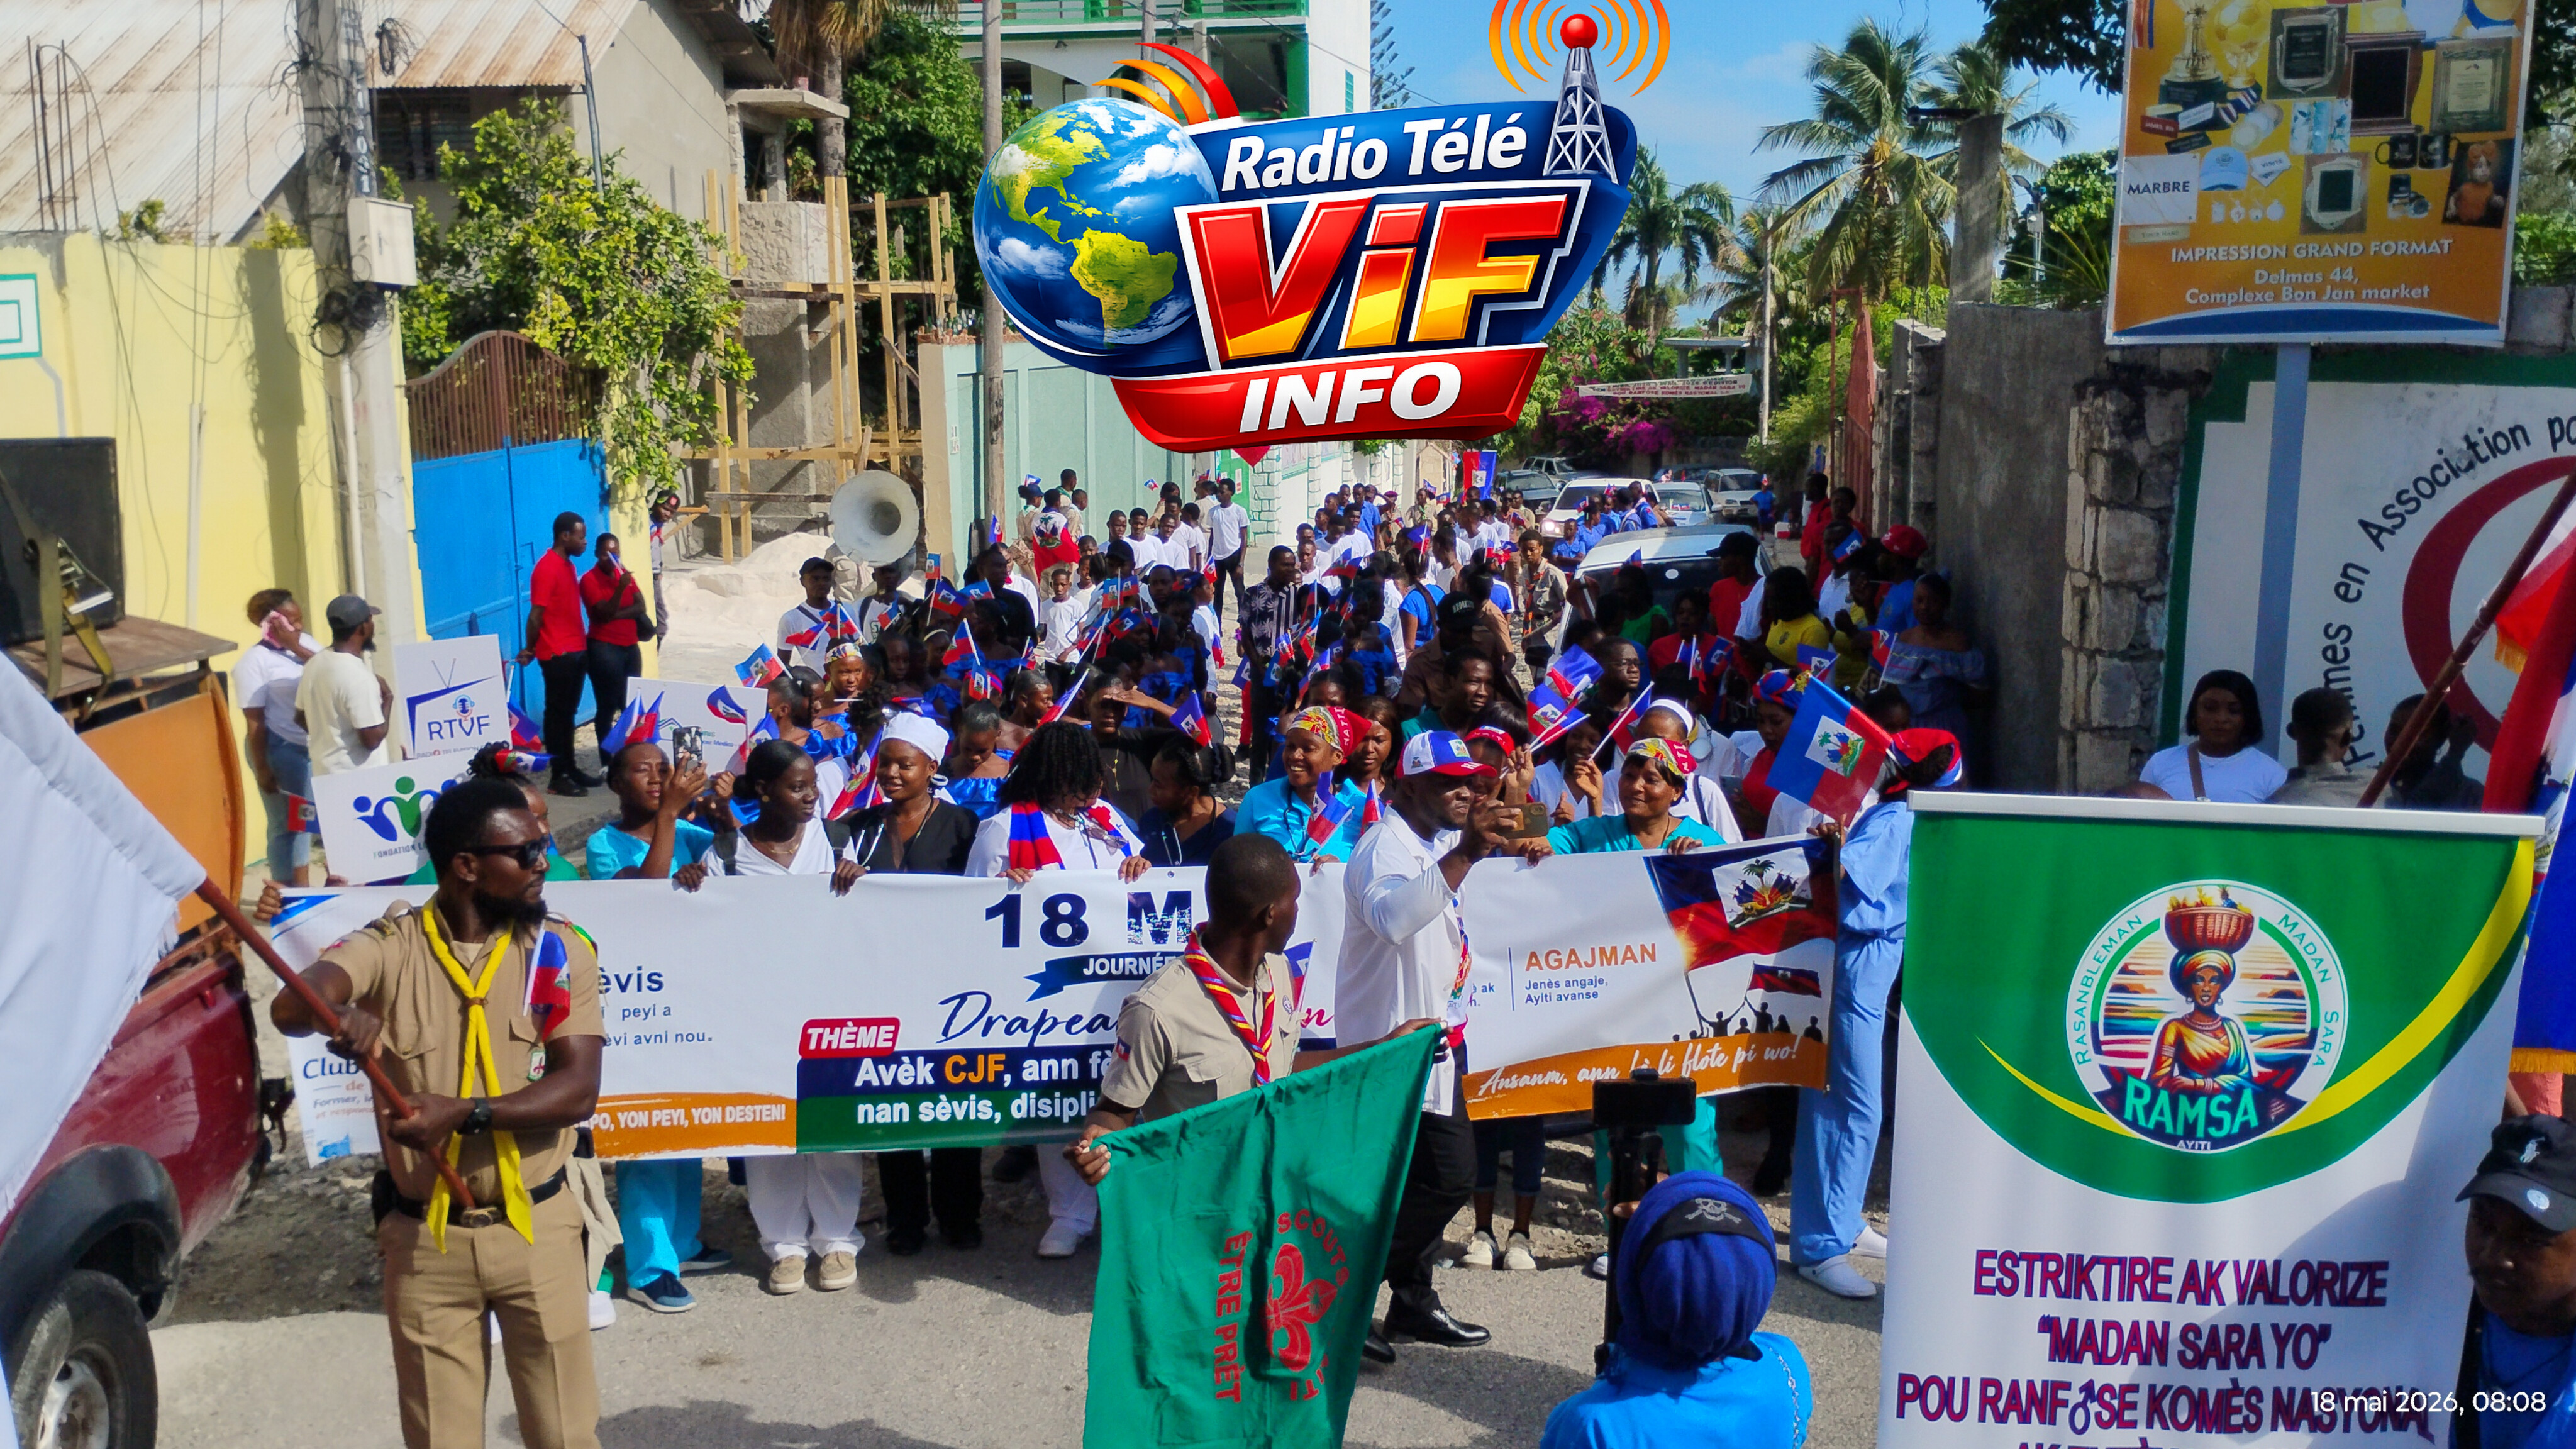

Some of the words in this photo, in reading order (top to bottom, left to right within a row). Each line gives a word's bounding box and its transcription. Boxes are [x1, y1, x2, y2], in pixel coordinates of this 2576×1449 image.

[2127, 180, 2190, 196] MARBRE
[2171, 243, 2287, 263] IMPRESSION
[2292, 242, 2365, 258] GRAND
[2370, 239, 2453, 256] FORMAT
[2255, 269, 2324, 286] Delmas
[2329, 267, 2359, 286] 44,
[2185, 287, 2275, 306] Complexe
[2282, 286, 2317, 303] Bon
[2323, 284, 2355, 301] Jan
[2362, 284, 2431, 300] market
[2358, 423, 2531, 552] Association
[2334, 562, 2370, 603] en
[2321, 622, 2376, 767] Fmes
[427, 715, 490, 741] RTVF
[985, 893, 1089, 948] 18
[1127, 890, 1192, 945] M
[1525, 943, 1657, 972] AGAJMAN
[2277, 914, 2332, 984] MADAN
[1524, 979, 1561, 991] Jenès
[1565, 975, 1608, 989] angaje,
[1524, 992, 1552, 1006] Ayiti
[1556, 991, 1599, 1002] avanse
[2074, 914, 2143, 1066] RASANBLEMAN
[621, 1004, 657, 1021] peyi
[662, 1006, 672, 1017] a
[935, 990, 1118, 1046] Drapea
[633, 1030, 669, 1045] avni
[674, 1031, 713, 1043] nou.
[807, 1021, 896, 1050] THÈME
[2312, 1011, 2340, 1066] SARA
[303, 1057, 360, 1079] Club
[854, 1056, 935, 1087] Avèk
[1022, 1058, 1079, 1082] ann
[1577, 1065, 1621, 1083] ann
[1732, 1045, 1756, 1073] pi
[618, 1111, 649, 1128] YON
[652, 1109, 689, 1128] PEYI,
[691, 1107, 723, 1124] YON
[857, 1101, 910, 1124] nan
[918, 1094, 1001, 1124] sèvis,
[1010, 1091, 1099, 1123] disipli
[2123, 1074, 2259, 1138] RAMSA
[2176, 1139, 2211, 1151] AYITI
[1277, 1208, 1350, 1287] SCOUTS
[1215, 1230, 1253, 1318] ÊTRE
[1974, 1249, 2175, 1304] ESTRIKTIRE
[2176, 1258, 2229, 1307] AK
[2232, 1258, 2390, 1309] VALORIZE
[2177, 1321, 2267, 1371] SARA
[1896, 1373, 1970, 1423] POU
[2145, 1377, 2265, 1435] KOMÈS
